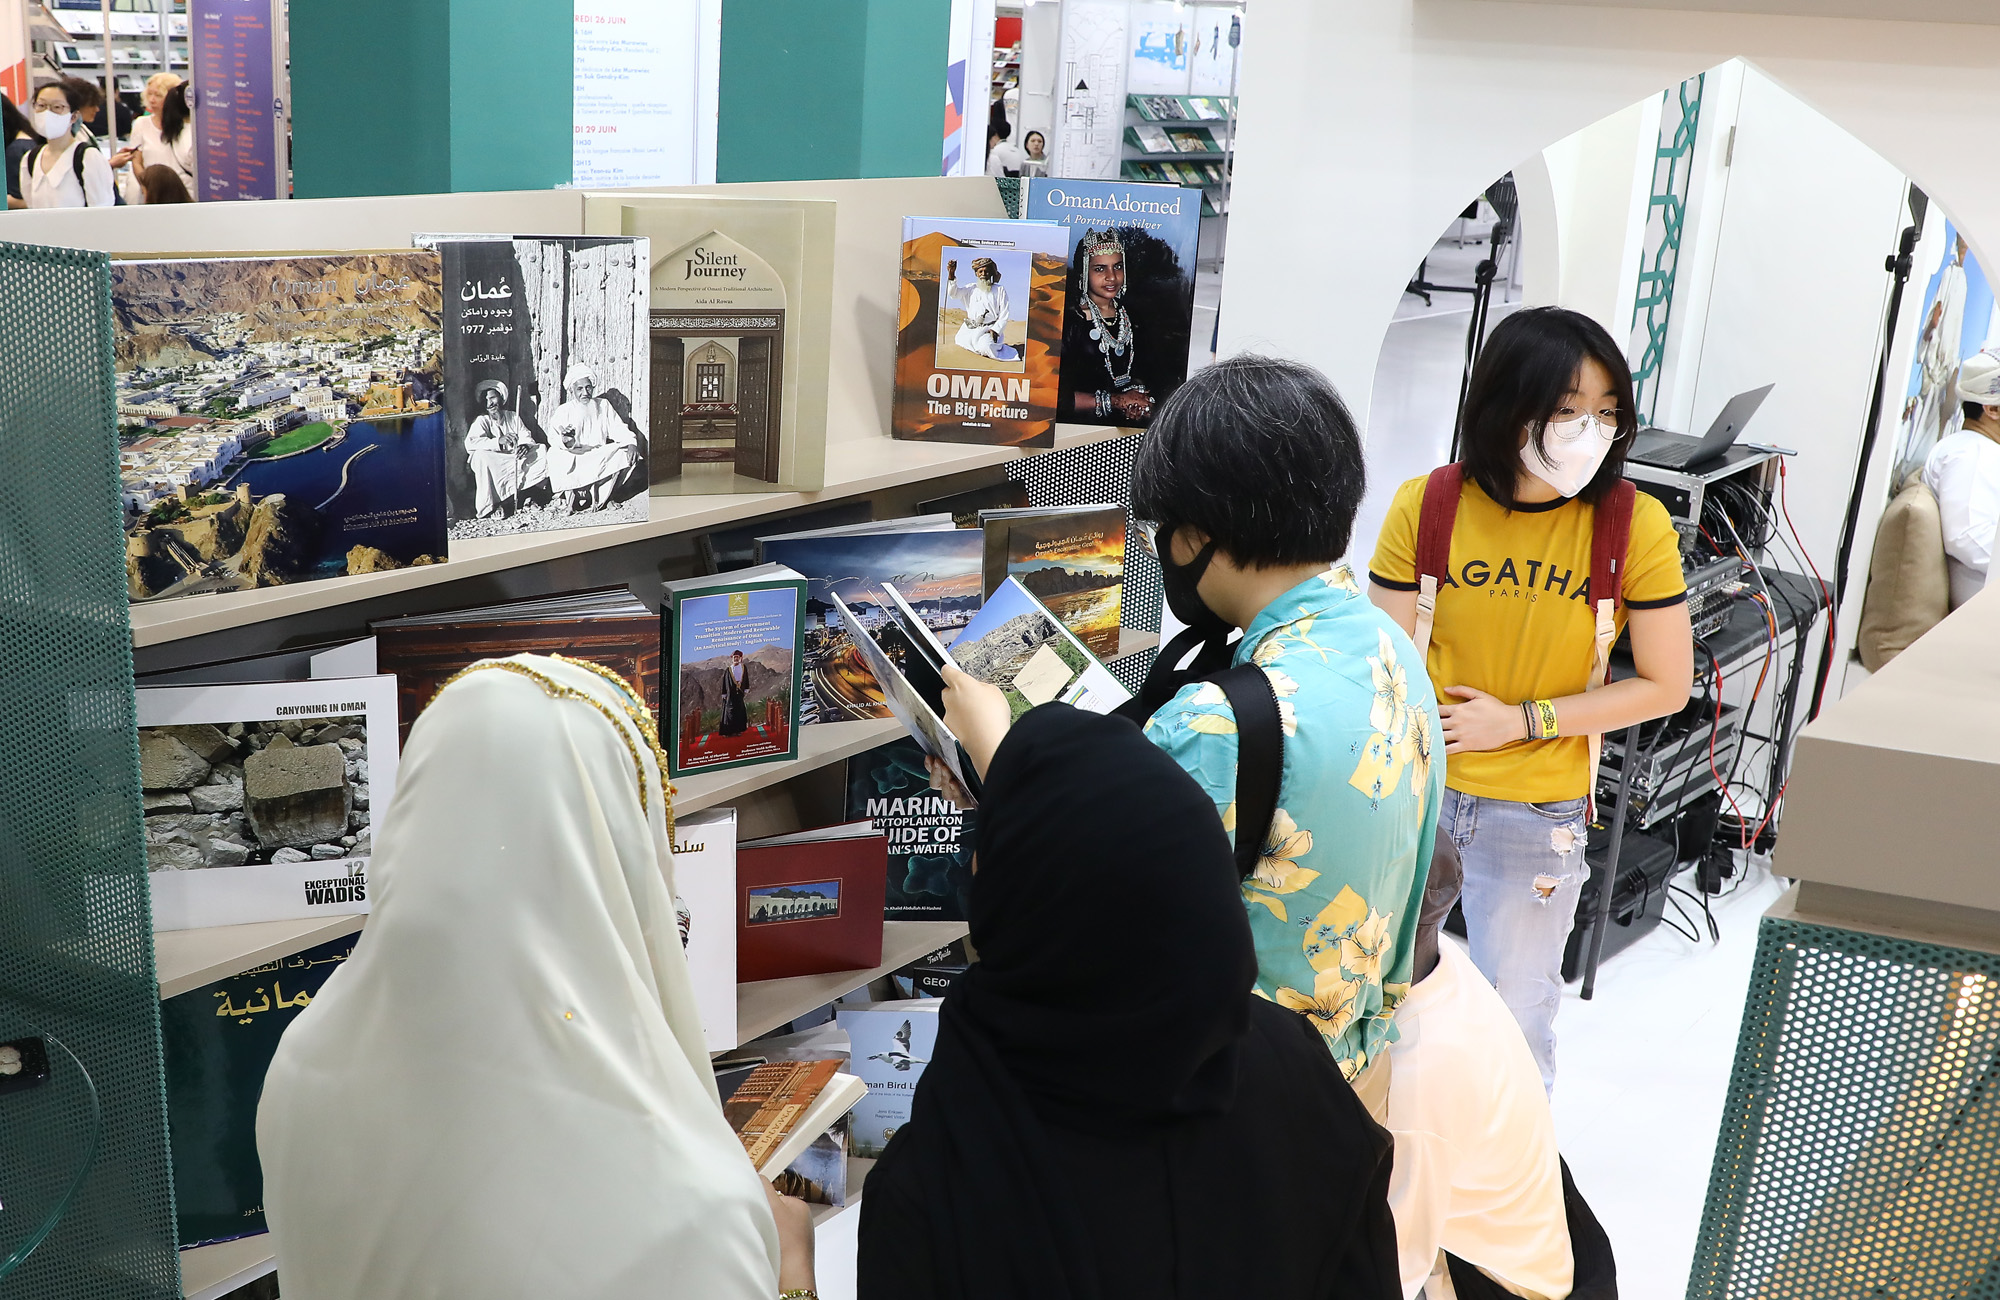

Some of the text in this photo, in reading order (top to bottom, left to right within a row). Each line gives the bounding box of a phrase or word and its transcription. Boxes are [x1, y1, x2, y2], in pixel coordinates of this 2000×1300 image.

[596, 16, 606, 24] 26
[607, 16, 626, 24] JUIN
[1062, 214, 1163, 230] A Portrait in Silver
[694, 248, 738, 266] Silent
[684, 260, 746, 280] Journey
[272, 279, 336, 294] Oman
[490, 308, 513, 317] وجوه
[460, 323, 513, 335] نوفمبر 1977
[927, 373, 1031, 402] OMAN
[927, 400, 1028, 420] The Big Picture
[1490, 589, 1538, 602] PARIS
[703, 642, 726, 650] Analytical
[276, 702, 366, 716] CANYONING IN OMAN
[934, 827, 962, 842] OF
[914, 844, 960, 854] WATERS
[345, 861, 364, 877] 12
[305, 876, 366, 890] EXCEPTIONAL
[305, 886, 366, 905] WADIS
